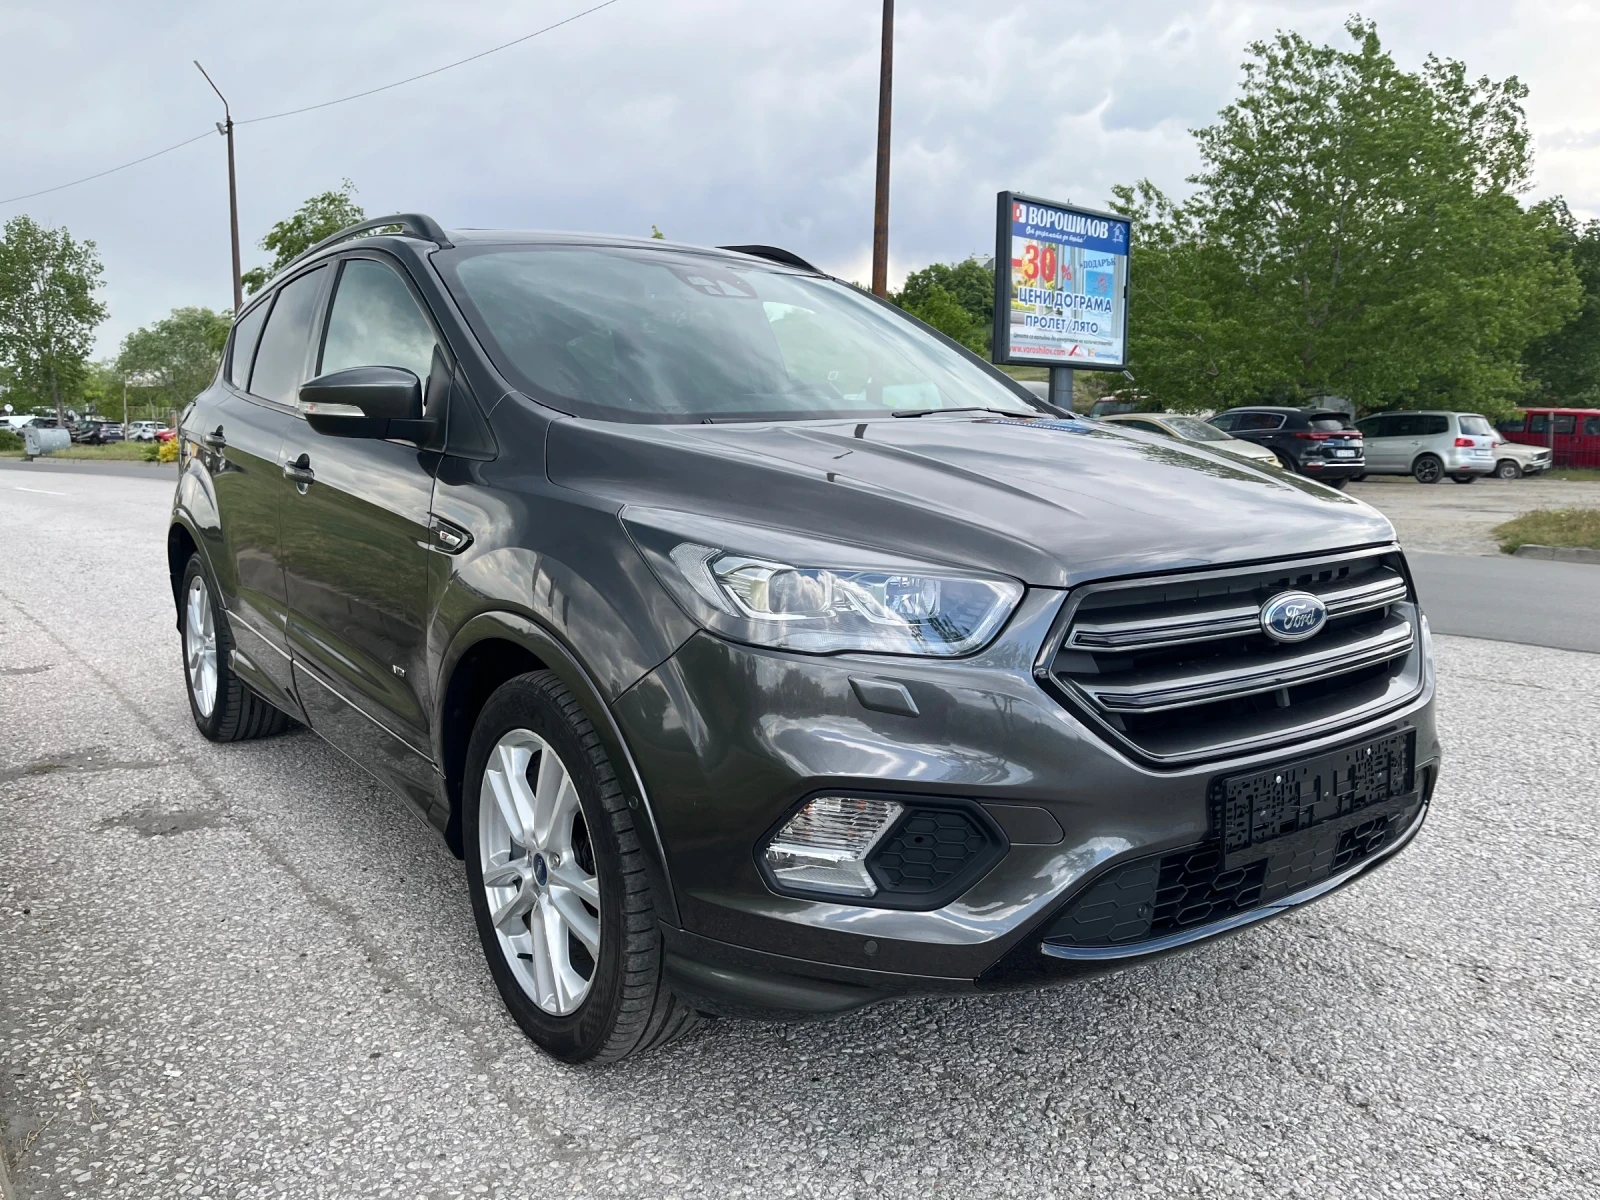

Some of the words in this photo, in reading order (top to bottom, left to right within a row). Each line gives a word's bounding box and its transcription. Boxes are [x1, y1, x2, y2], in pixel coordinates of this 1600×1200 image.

[1029, 206, 1109, 239] ВОРОШИЛОВ
[1019, 287, 1052, 305] ЦЕНИ
[1054, 293, 1112, 313] ДОГРАМА
[1025, 315, 1098, 333] ПРОЛЕТ/ЛЯТО
[1283, 604, 1316, 630] Ford
